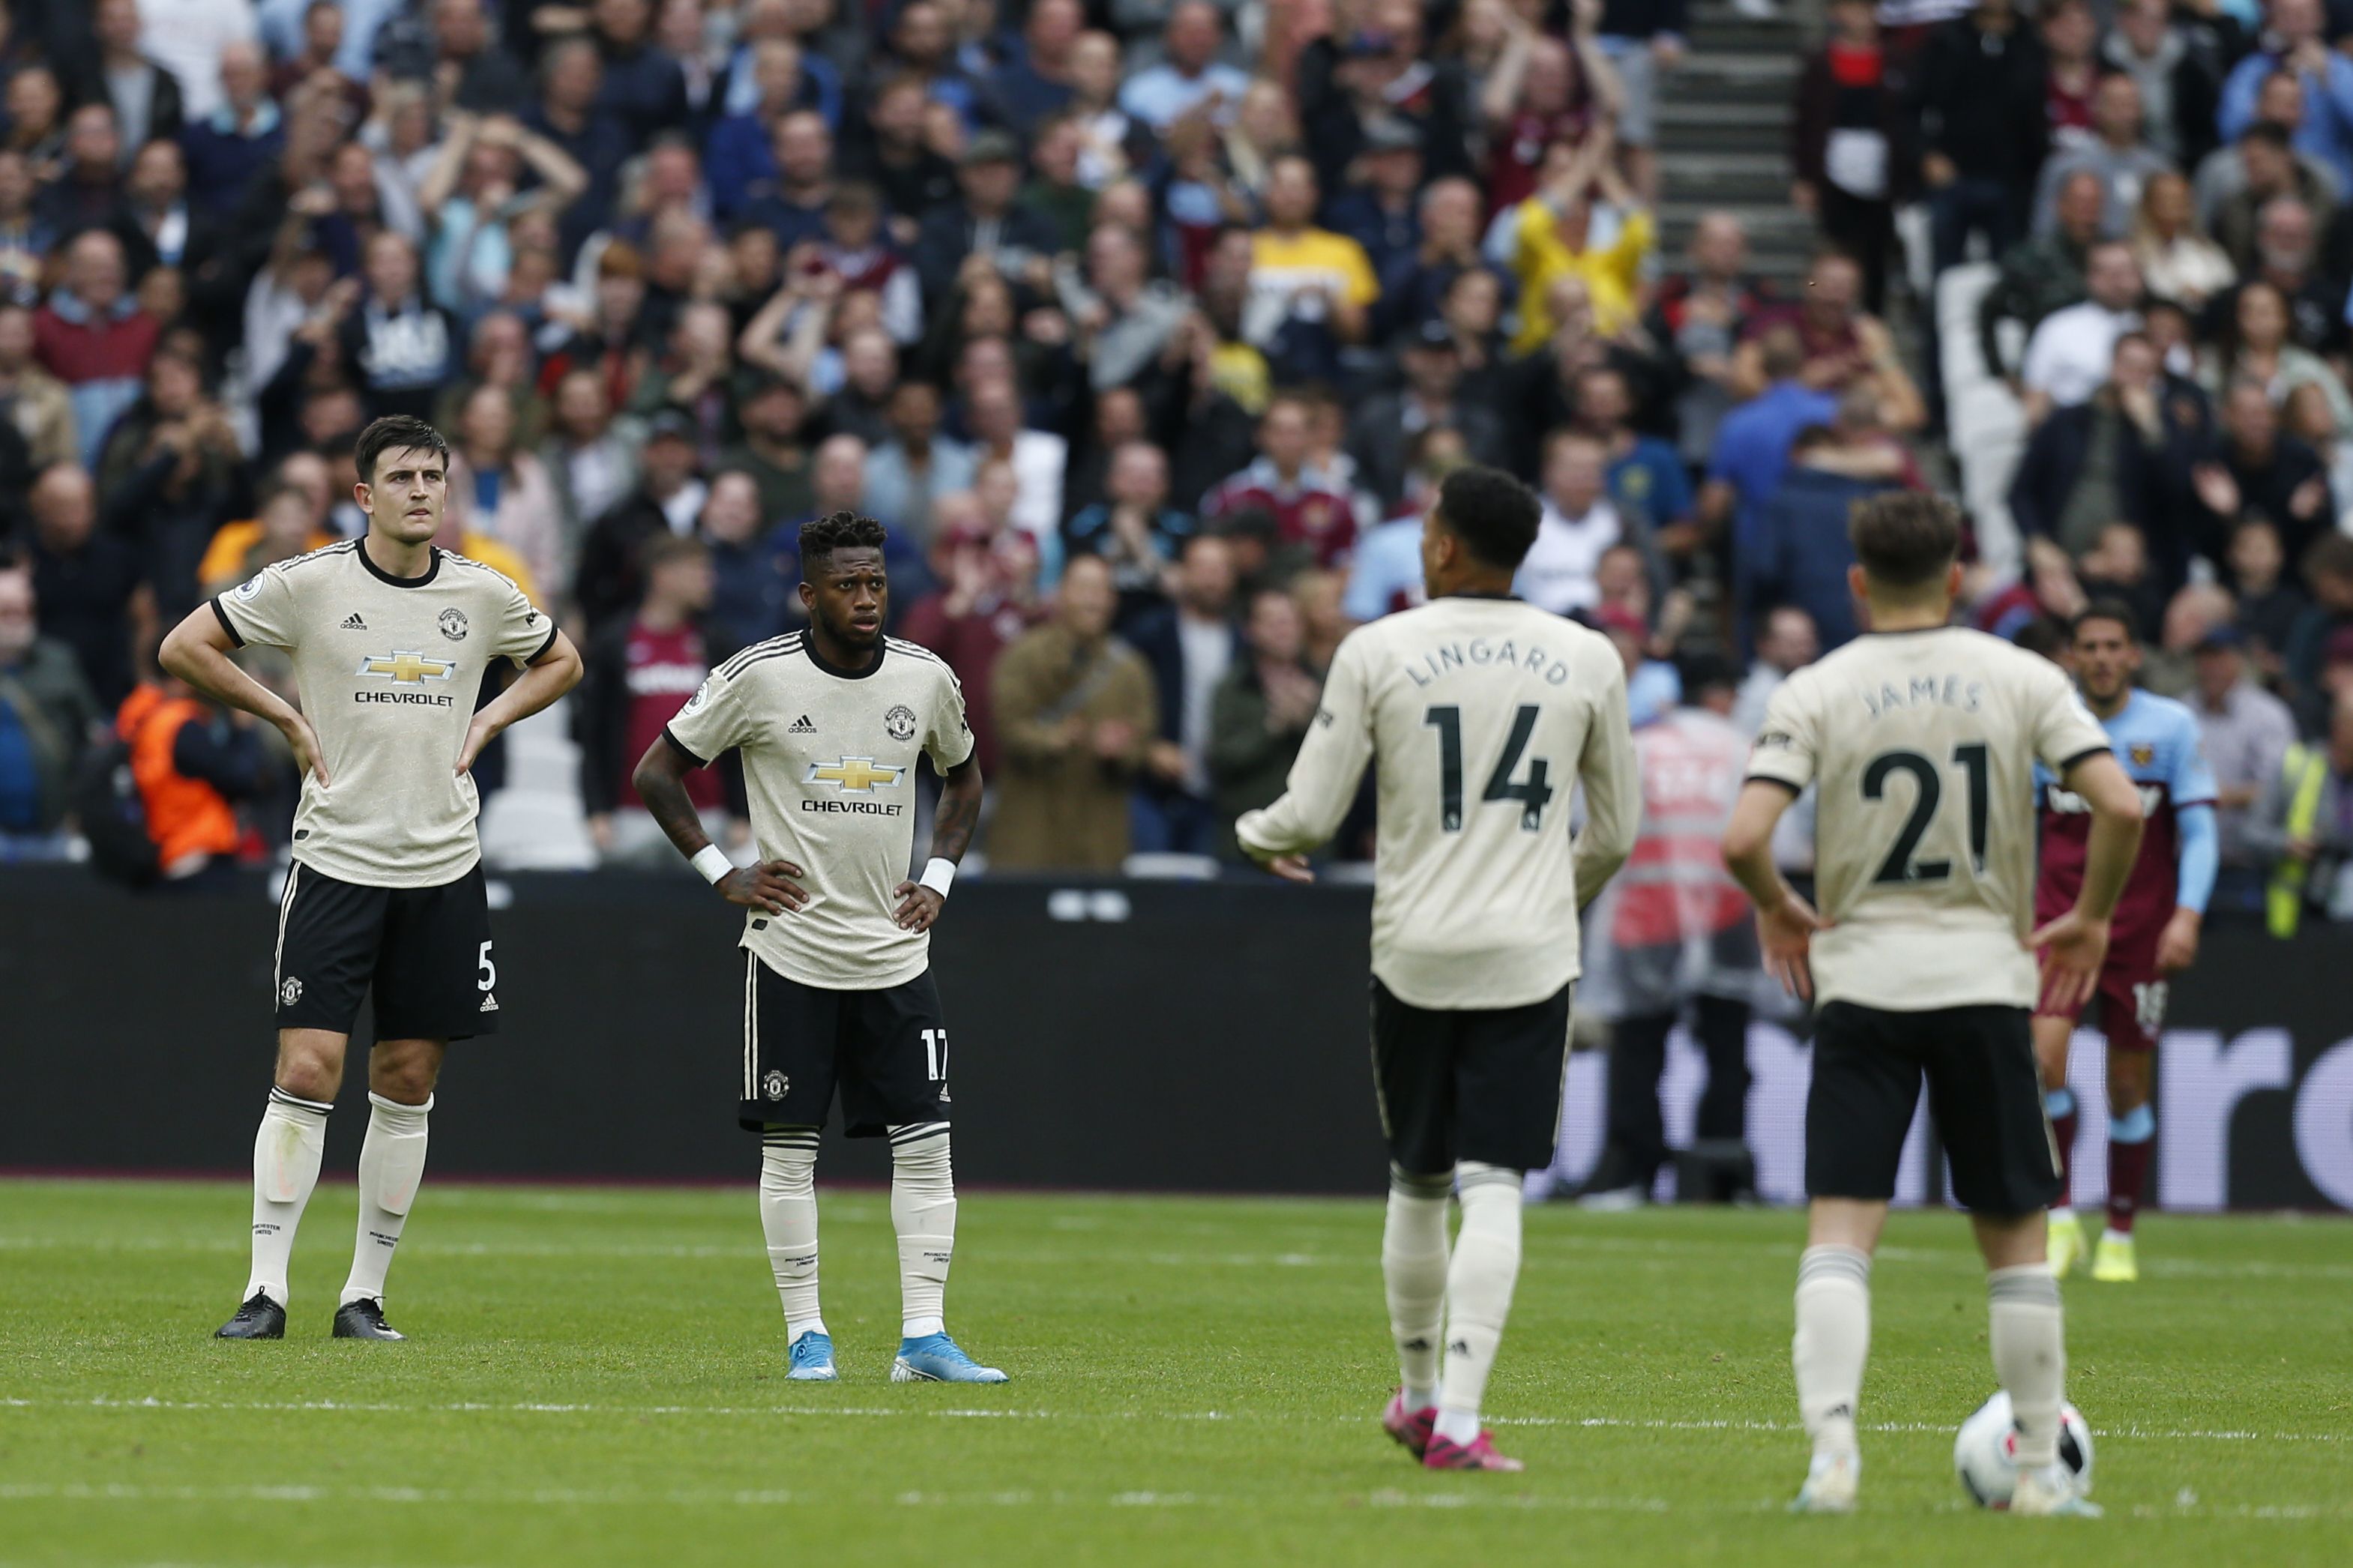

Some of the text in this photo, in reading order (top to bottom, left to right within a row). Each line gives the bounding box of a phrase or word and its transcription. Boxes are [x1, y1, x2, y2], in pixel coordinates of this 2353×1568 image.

[1406, 638, 1568, 687] LINGARD
[355, 692, 454, 707] CHEVROLET
[1862, 676, 1981, 718] JAMES
[1426, 705, 1553, 832] 14
[801, 800, 903, 816] CHEVROLET
[1863, 744, 1989, 883] 21
[477, 939, 496, 991] 5
[921, 1028, 948, 1080] 17
